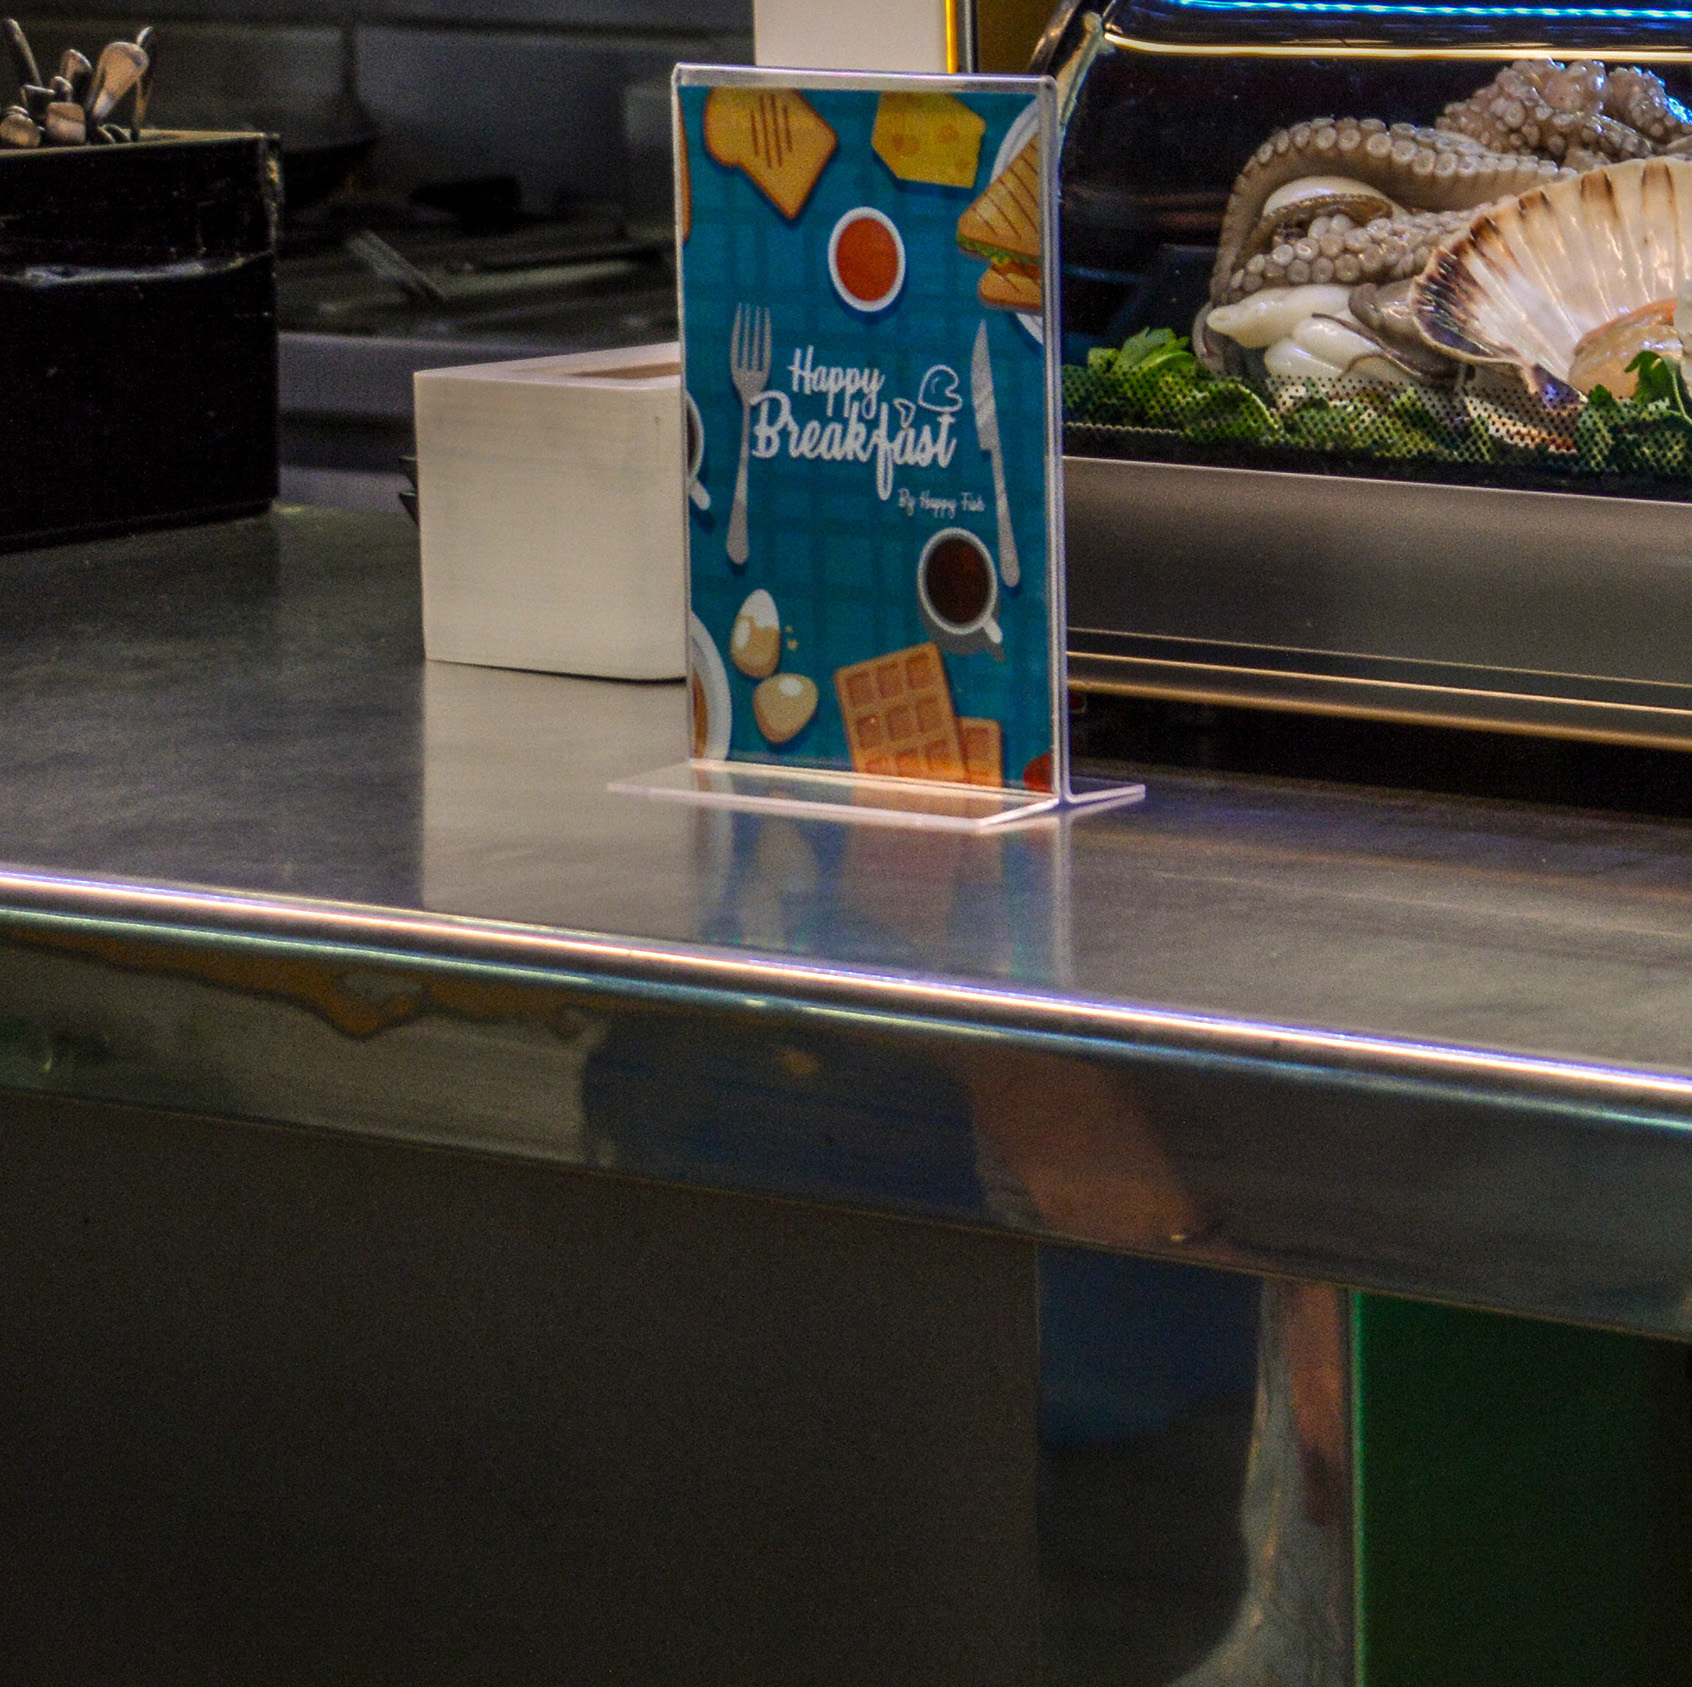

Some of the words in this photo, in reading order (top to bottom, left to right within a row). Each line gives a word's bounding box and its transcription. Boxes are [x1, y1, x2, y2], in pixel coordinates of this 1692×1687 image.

[787, 345, 886, 420] Happy
[750, 390, 957, 501] Breakfast
[898, 488, 916, 516] By
[919, 490, 957, 519] Happy
